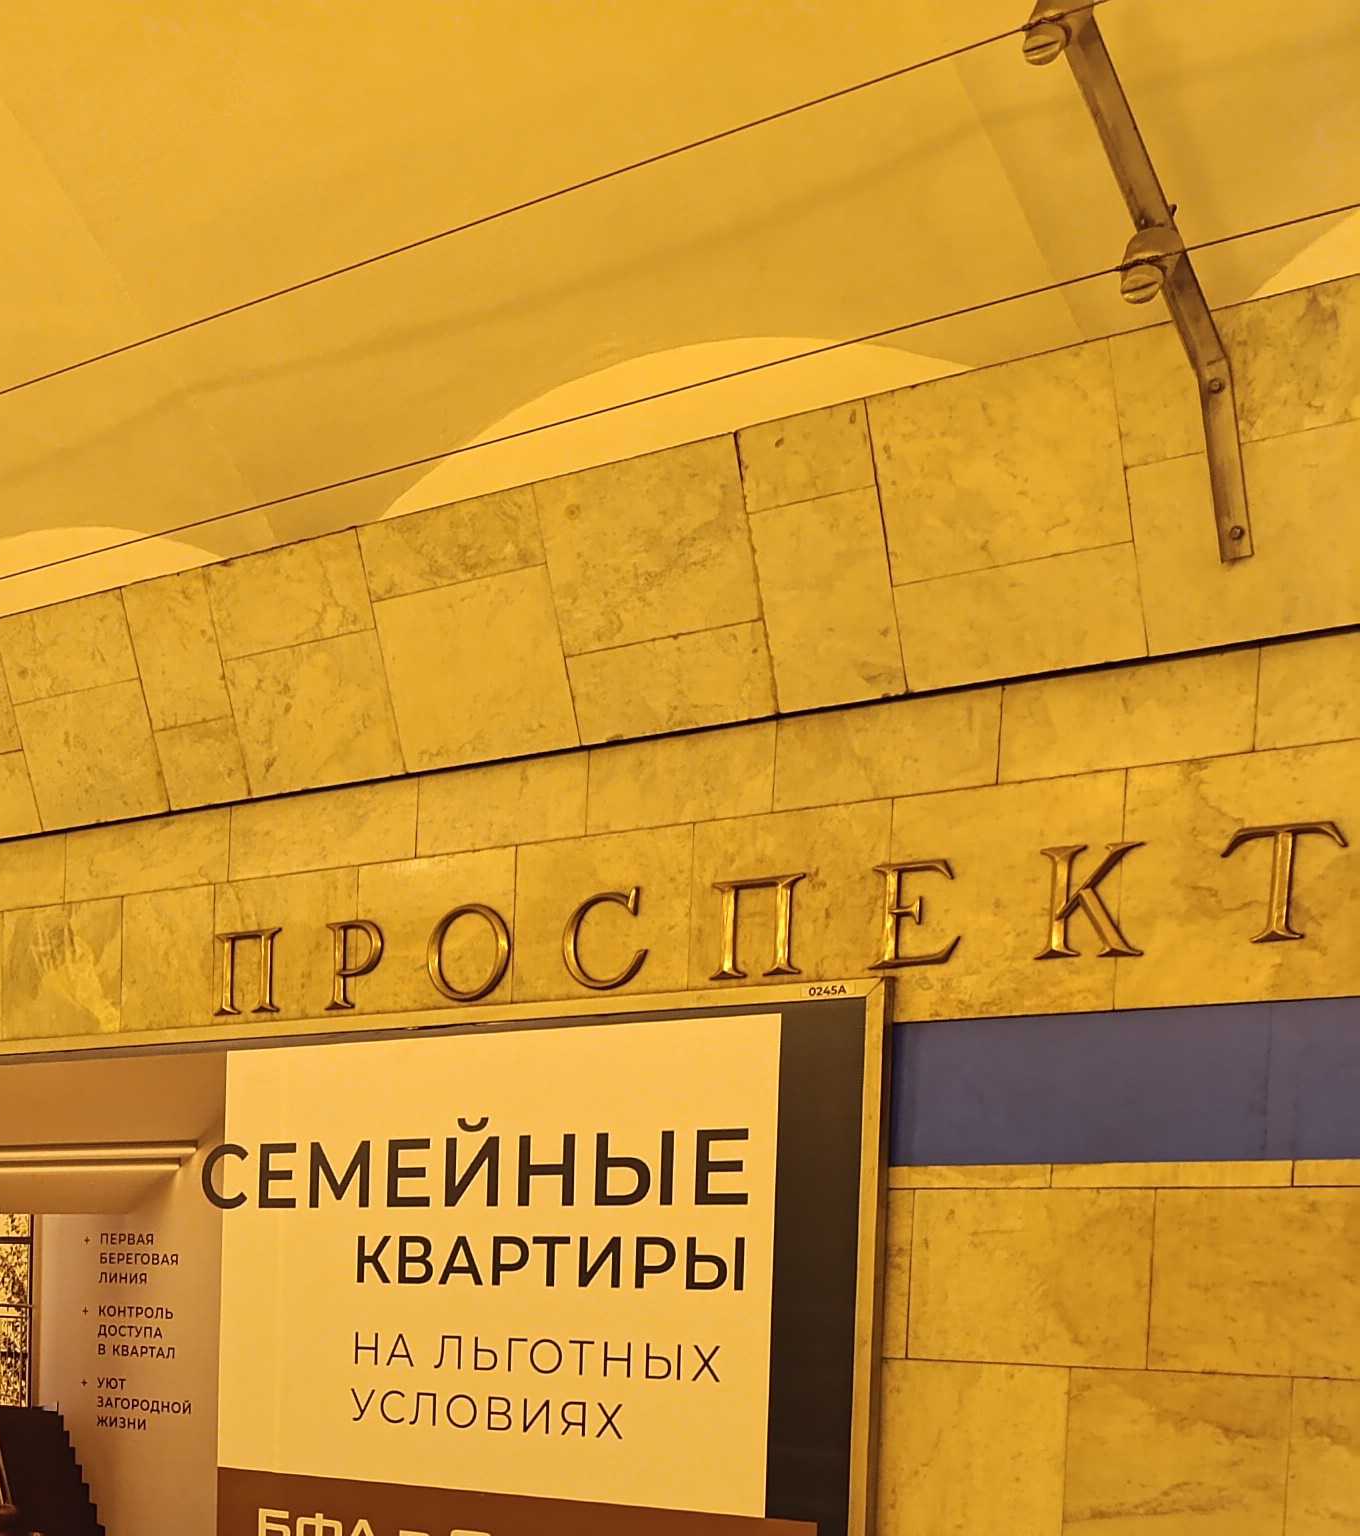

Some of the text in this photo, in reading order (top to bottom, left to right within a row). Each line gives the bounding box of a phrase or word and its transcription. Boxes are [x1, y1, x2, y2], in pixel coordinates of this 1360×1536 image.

[213, 820, 1349, 1017] ПРОСПЕКТ
[808, 984, 847, 997] 0245A
[200, 1117, 750, 1210] СЕМЕЙНЫЕ
[100, 1233, 155, 1246] ПЕРВАЯ
[99, 1253, 179, 1266] БЕРЕГОВАЯ
[354, 1235, 747, 1292] КВАРТИРЫ
[98, 1272, 147, 1285] ЛИНИЯ
[98, 1305, 174, 1320] КОНТРОЛЬ
[97, 1324, 163, 1339] ДОСТУПА
[98, 1344, 176, 1359] В КВАРТАЛ
[352, 1331, 722, 1384] НА ЛЬГОТНЫХ
[97, 1377, 126, 1390] УЮТ
[96, 1396, 192, 1415] ЗАГОРОДНОЙ
[350, 1388, 625, 1440] УСЛОВИЯХ
[96, 1416, 146, 1430] ЖИЗНИ
